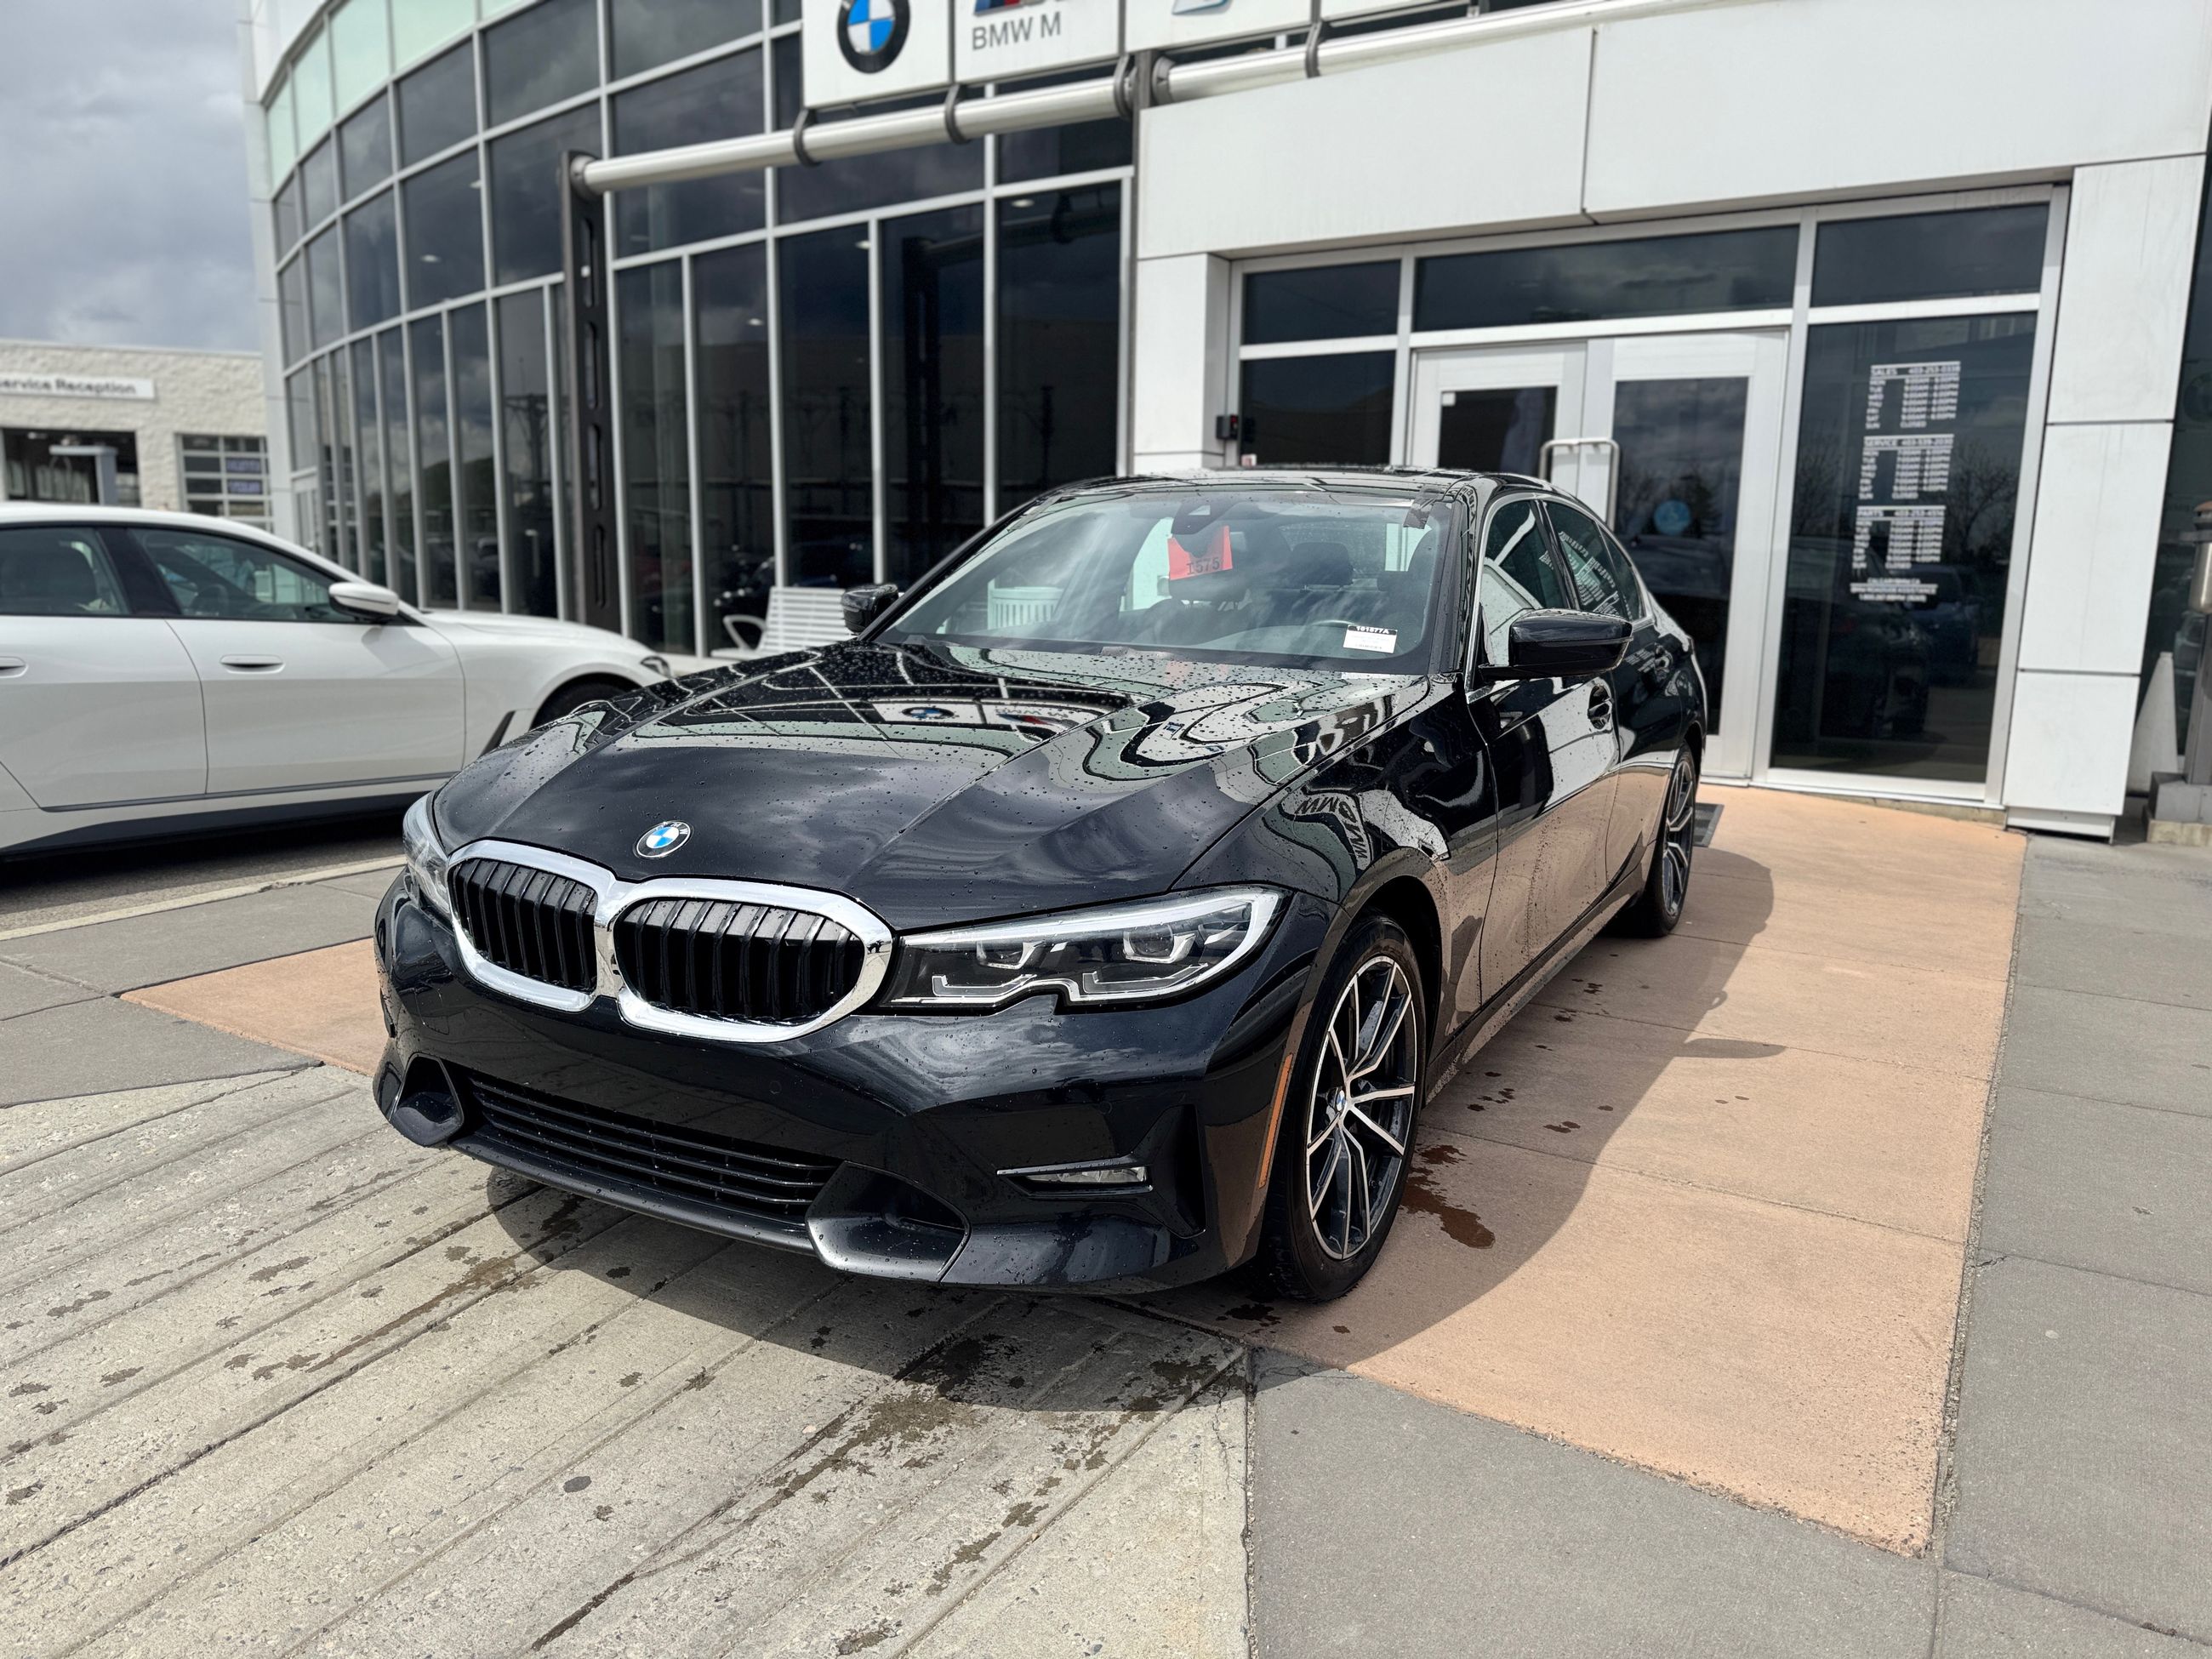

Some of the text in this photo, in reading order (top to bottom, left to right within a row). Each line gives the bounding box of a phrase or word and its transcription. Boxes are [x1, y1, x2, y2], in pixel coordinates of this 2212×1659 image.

[972, 12, 1061, 50] BMW M
[55, 379, 136, 395] Reception
